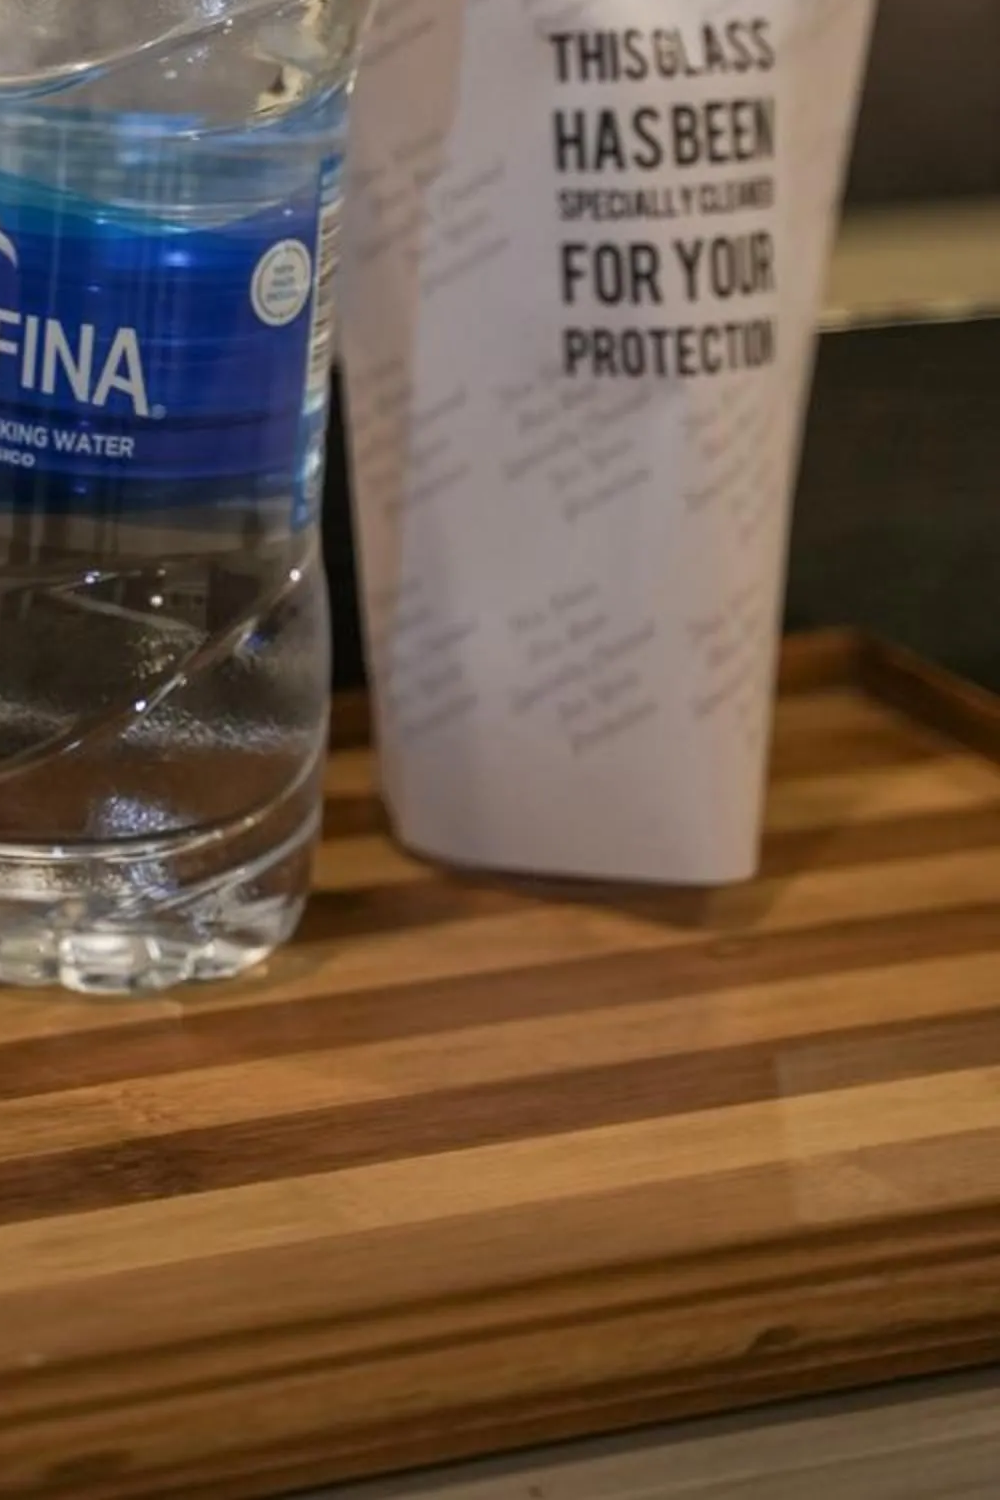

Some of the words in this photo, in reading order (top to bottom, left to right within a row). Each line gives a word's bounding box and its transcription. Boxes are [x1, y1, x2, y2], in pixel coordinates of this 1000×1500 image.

[549, 26, 650, 85] THIS
[652, 15, 777, 78] GLASS
[552, 105, 664, 174] HAS
[560, 241, 665, 306] FOR
[674, 231, 777, 302] YOUR
[53, 428, 135, 458] WATER
